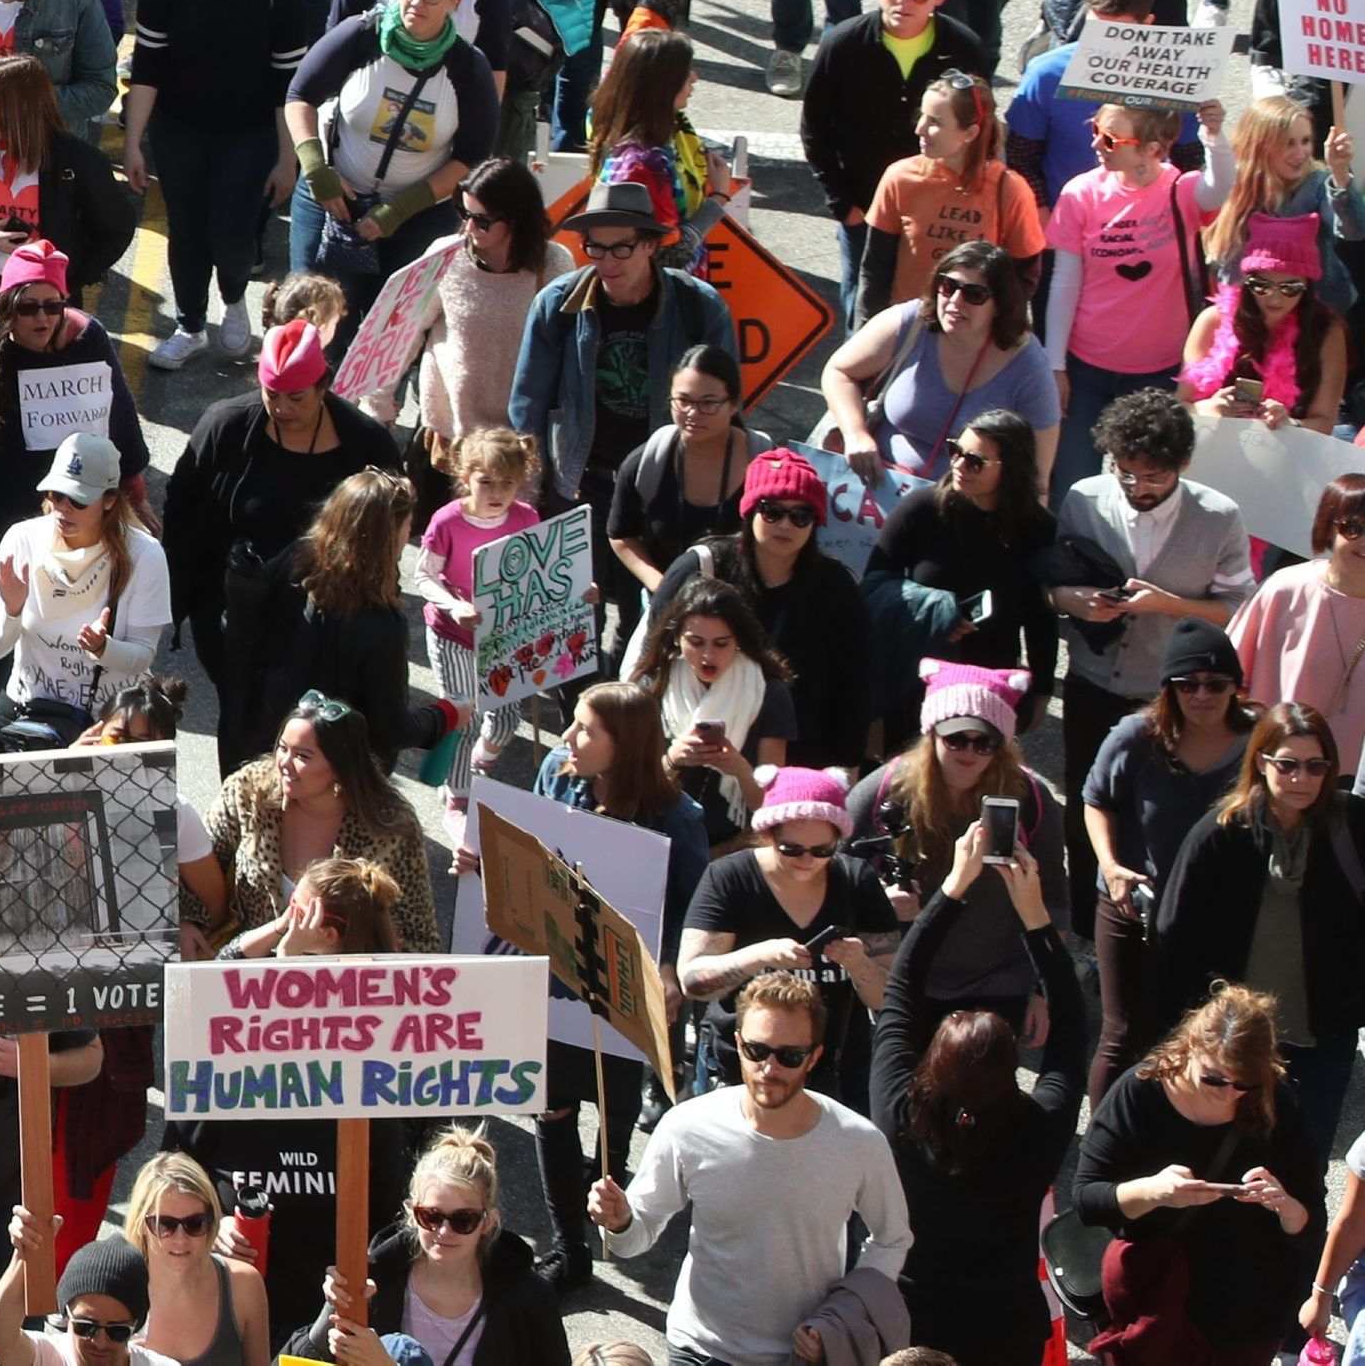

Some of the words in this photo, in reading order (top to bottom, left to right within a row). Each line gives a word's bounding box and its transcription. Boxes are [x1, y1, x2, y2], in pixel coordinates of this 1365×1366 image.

[1090, 71, 1198, 96] COVERAGE
[1124, 95, 1152, 106] OUR
[939, 206, 981, 224] LEAD
[23, 376, 102, 402] MARCH
[474, 510, 588, 597] LOVE
[66, 988, 77, 1014] 1
[93, 982, 159, 1011] VOTE
[222, 967, 458, 1010] WOMEN'S
[390, 1011, 484, 1053] ARE
[169, 1060, 344, 1113] HUMAN
[279, 1151, 319, 1168] WILD
